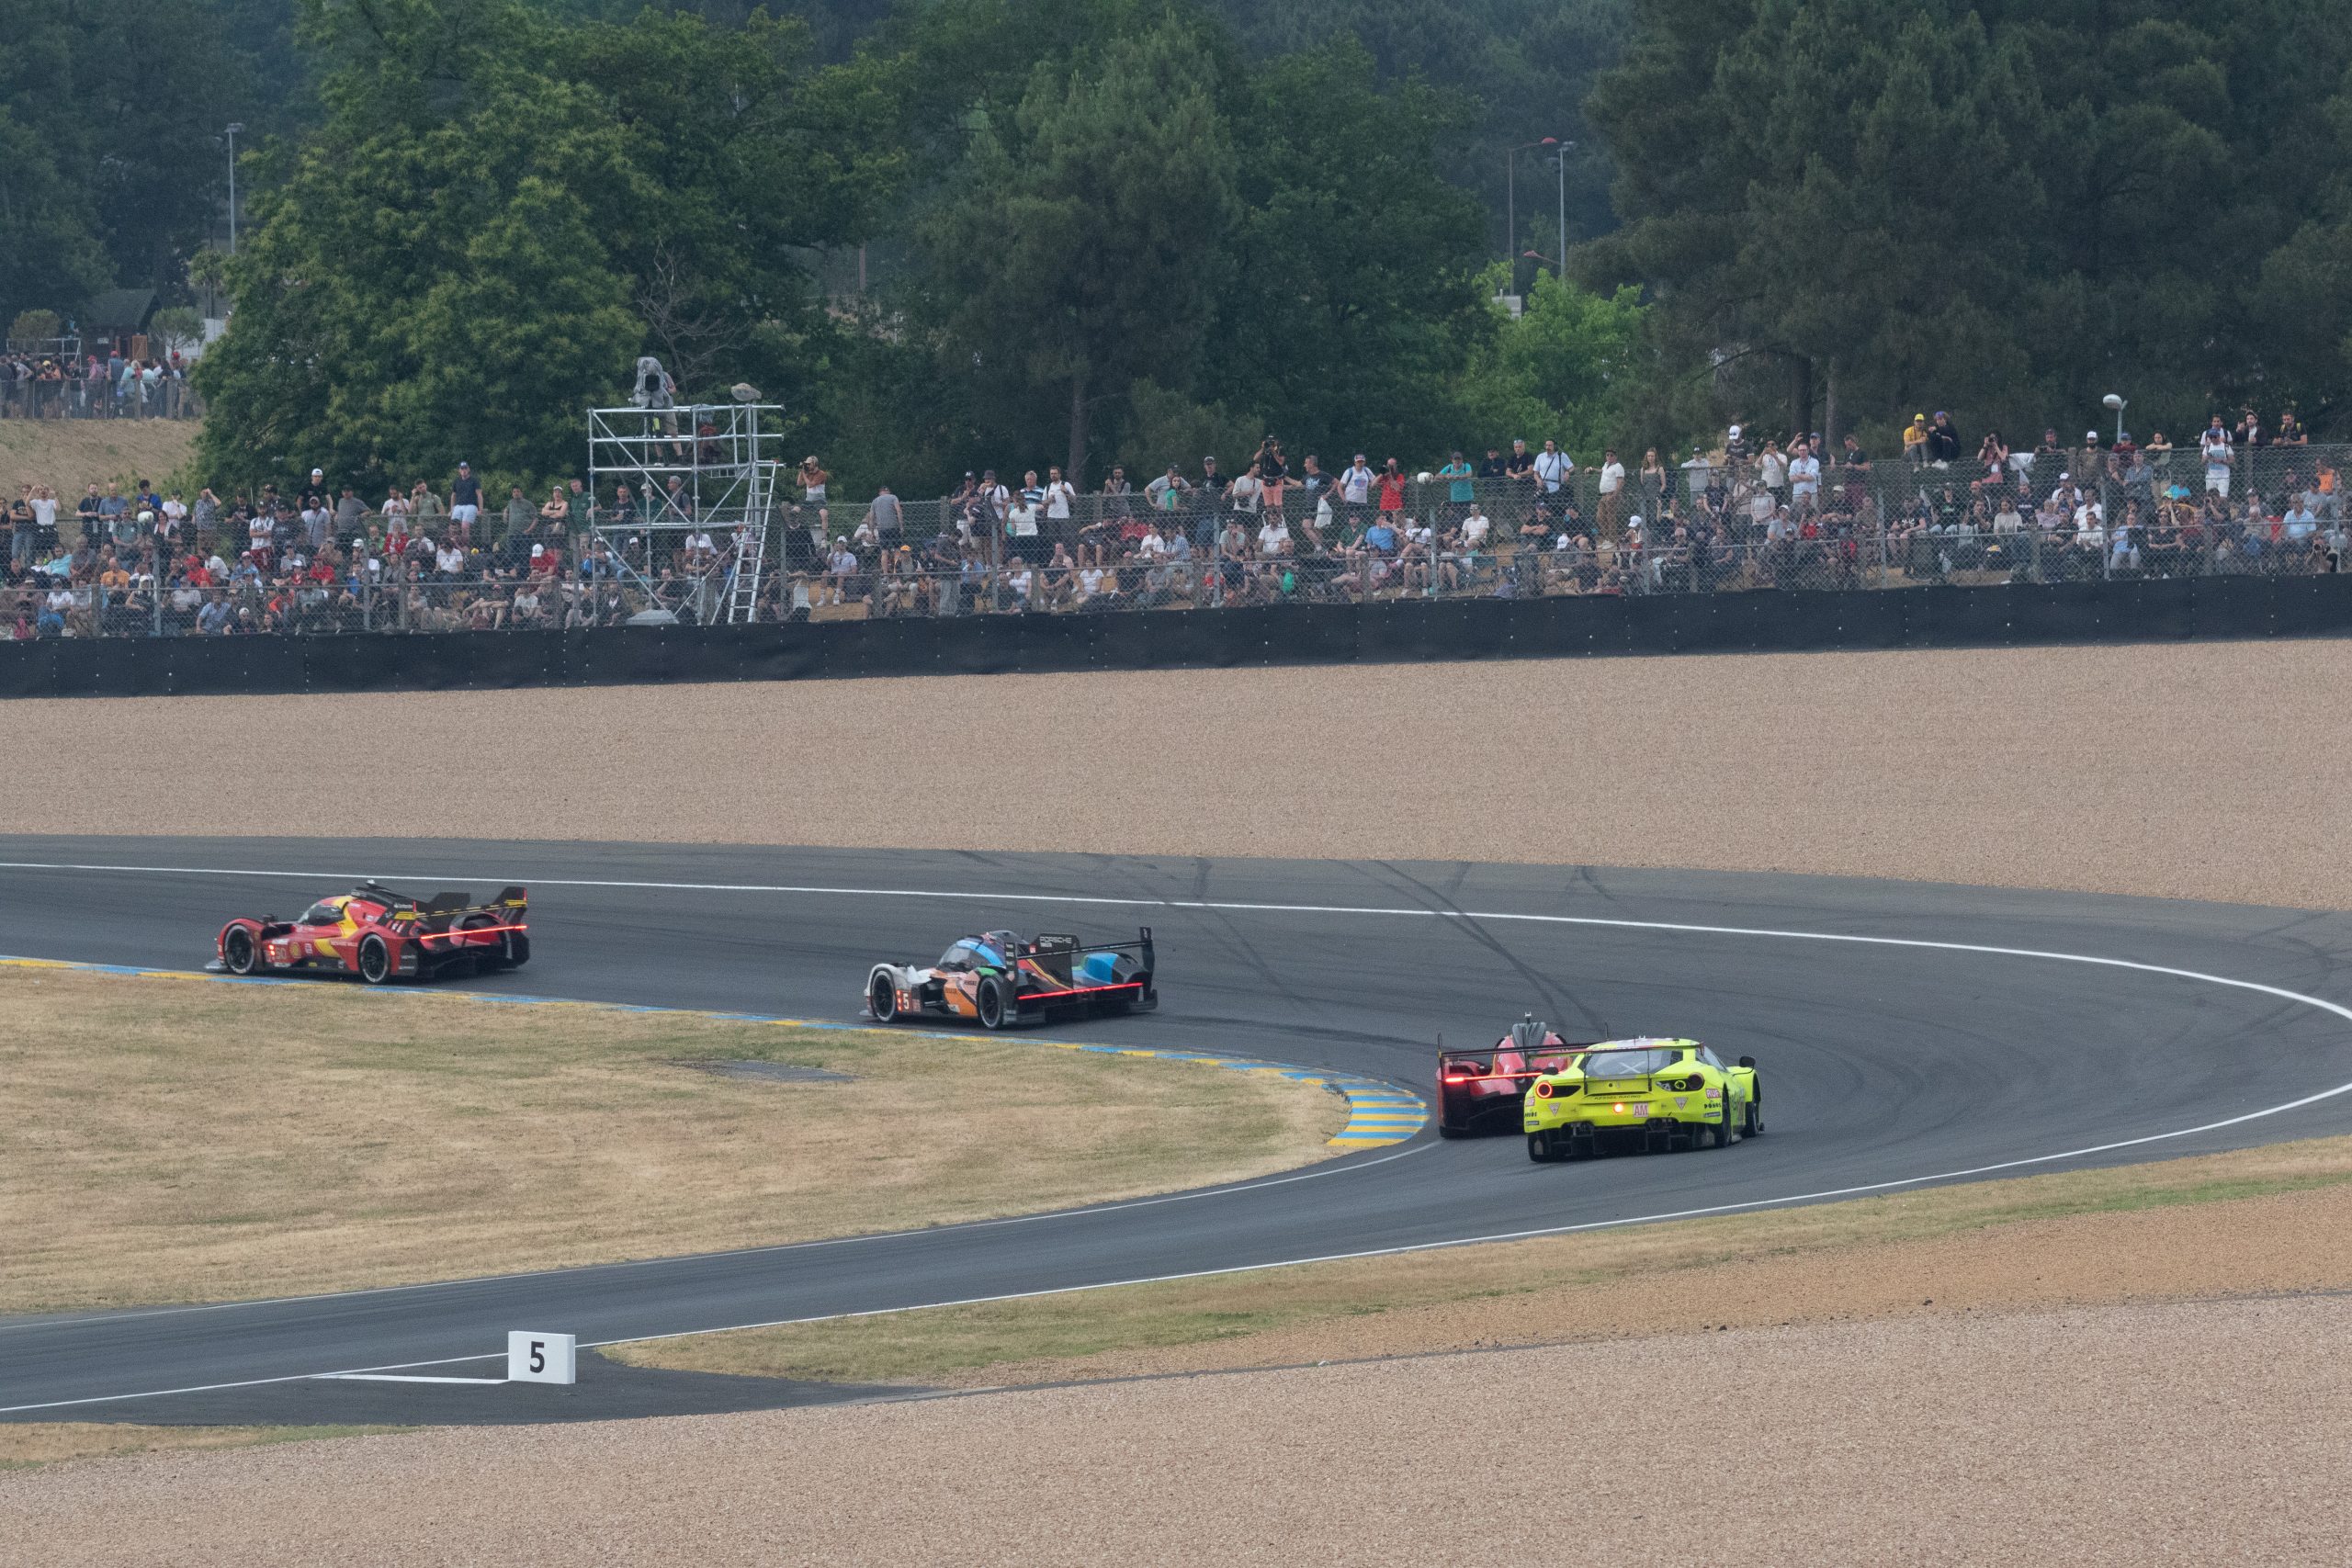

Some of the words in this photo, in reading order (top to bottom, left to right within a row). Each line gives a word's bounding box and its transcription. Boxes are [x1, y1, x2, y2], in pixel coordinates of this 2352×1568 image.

[1040, 936, 1072, 944] PORSCHE
[902, 993, 910, 1010] 5
[1634, 1103, 1648, 1116] AM
[529, 1349, 545, 1374] 5
